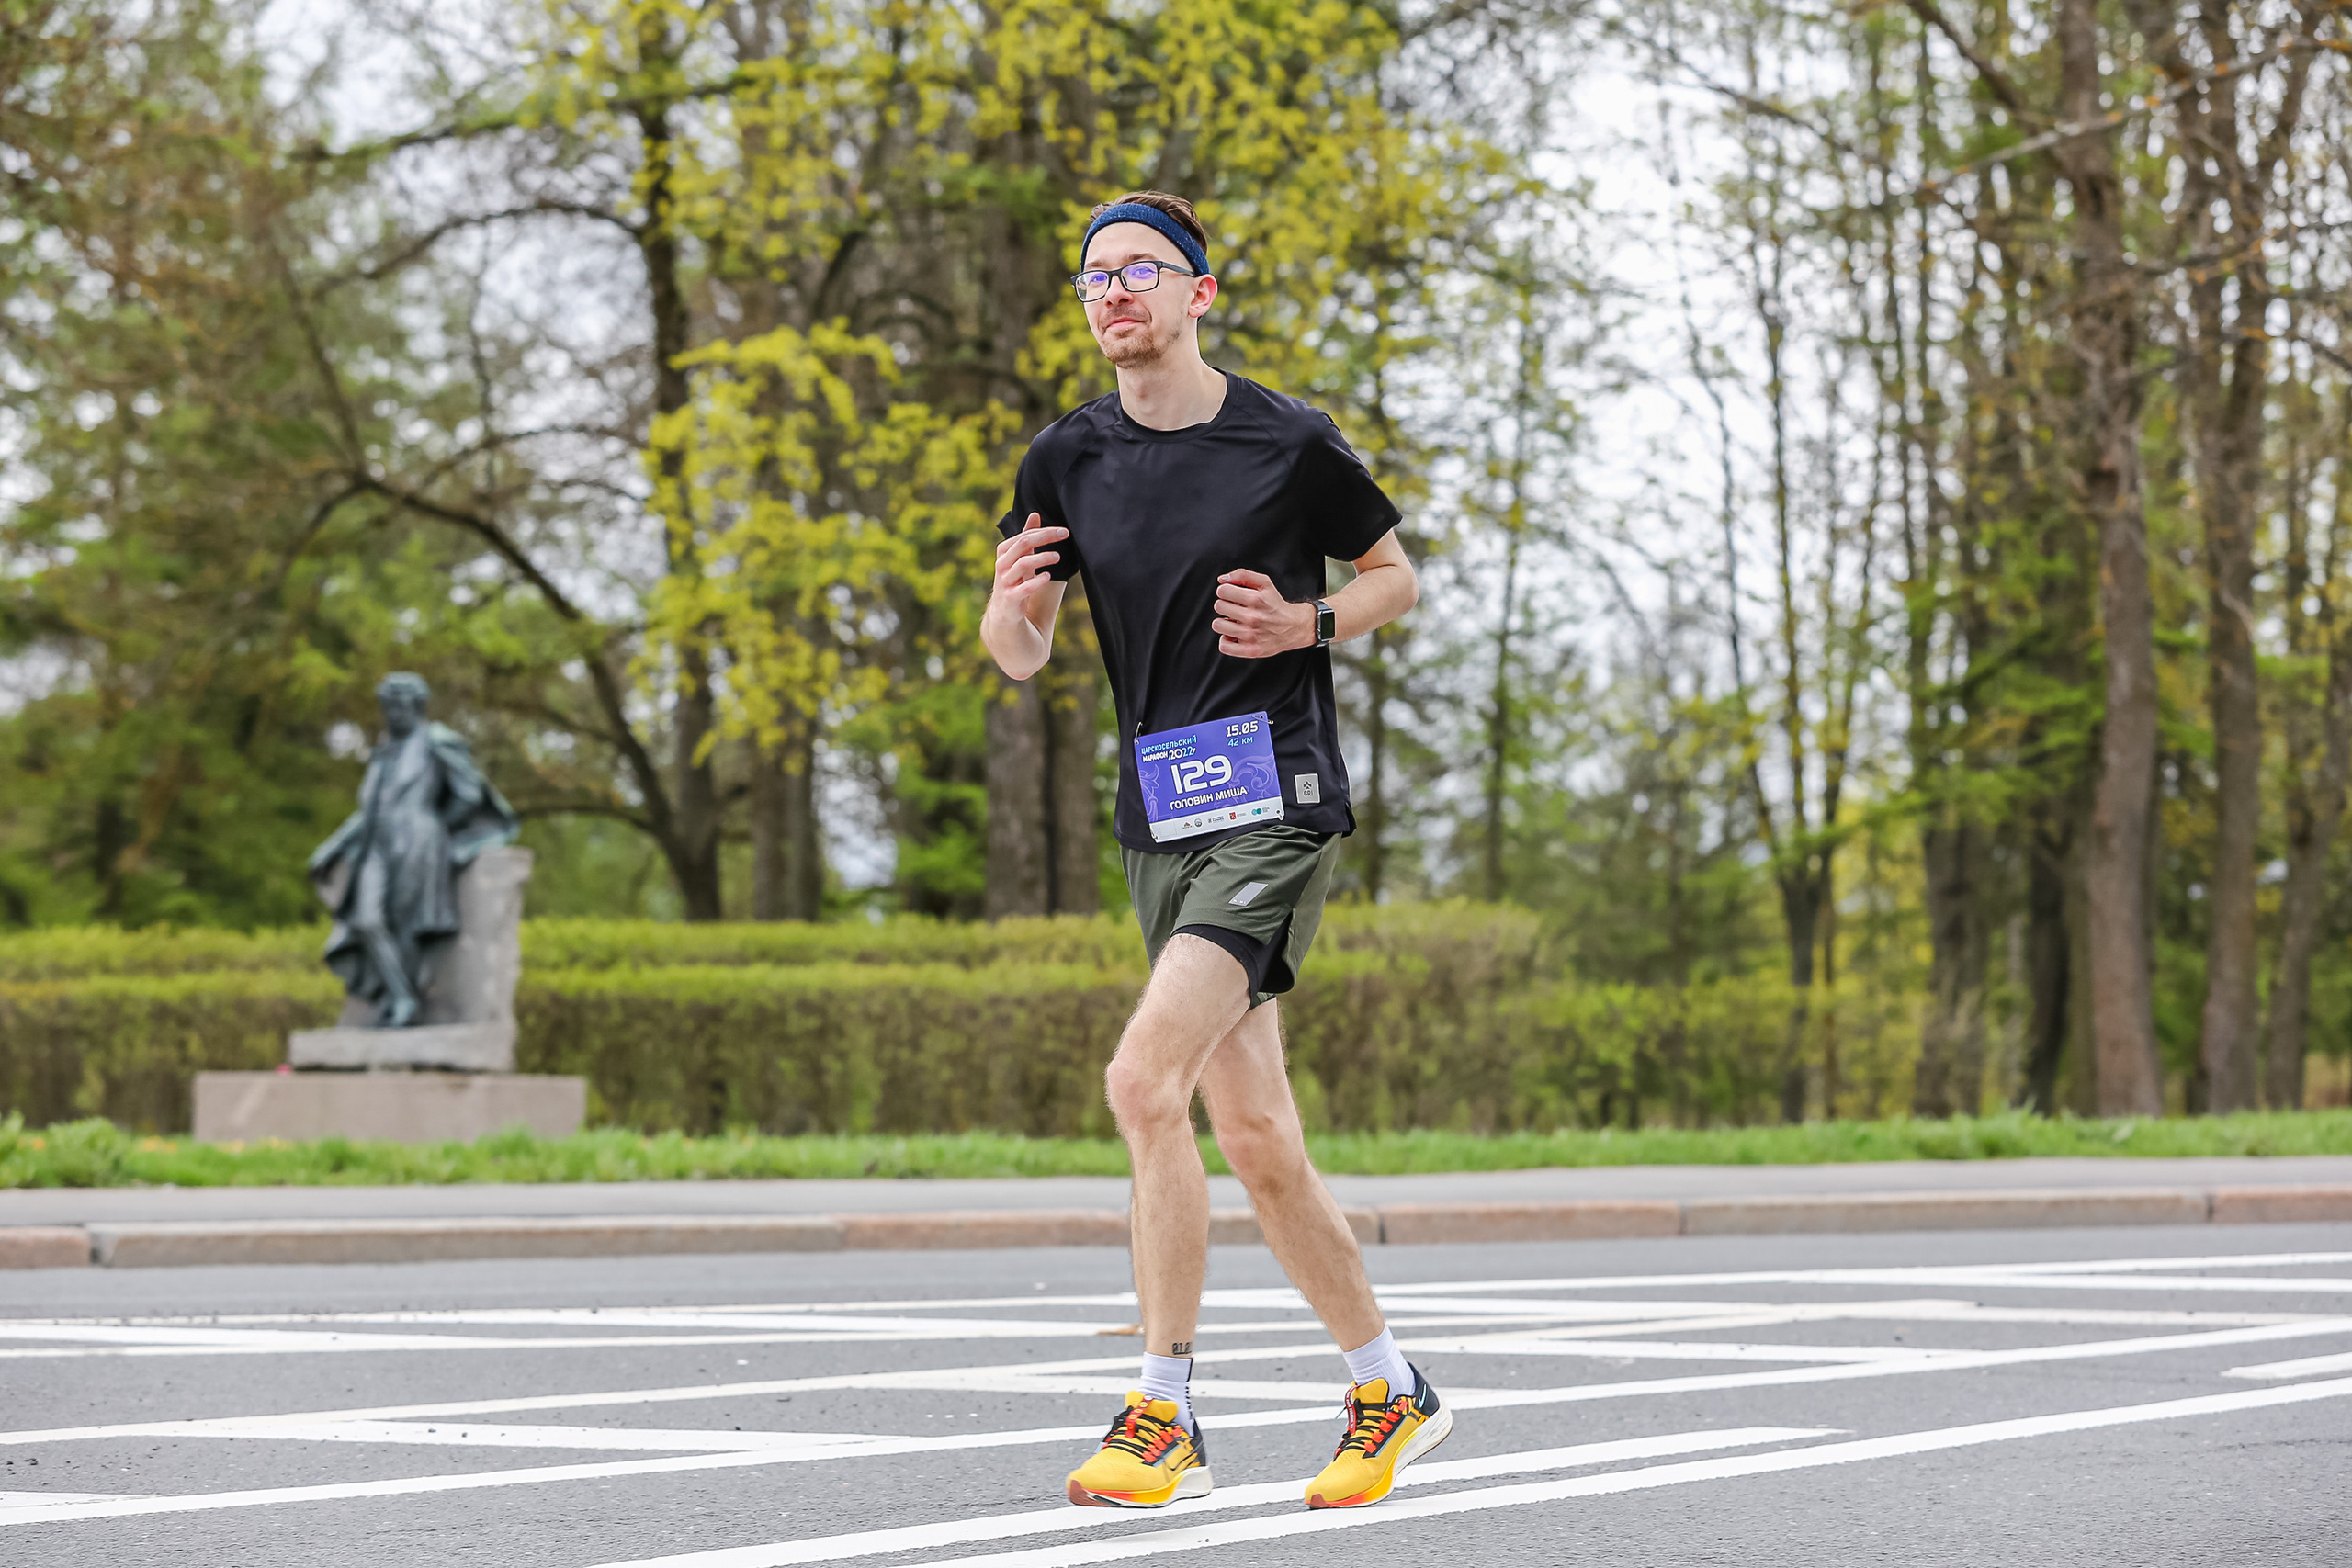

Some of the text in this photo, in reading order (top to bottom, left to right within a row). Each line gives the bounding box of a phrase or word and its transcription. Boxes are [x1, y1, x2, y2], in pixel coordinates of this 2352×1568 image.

[1226, 720, 1259, 738] 15.05
[1141, 734, 1196, 754] ЦАРСКОСЕЛЬСКИЙ
[1227, 738, 1239, 747] 42
[1142, 750, 1169, 762] МАРАФОН
[1170, 754, 1232, 794] 129
[1170, 785, 1249, 810] ГОЛОВИН МИША
